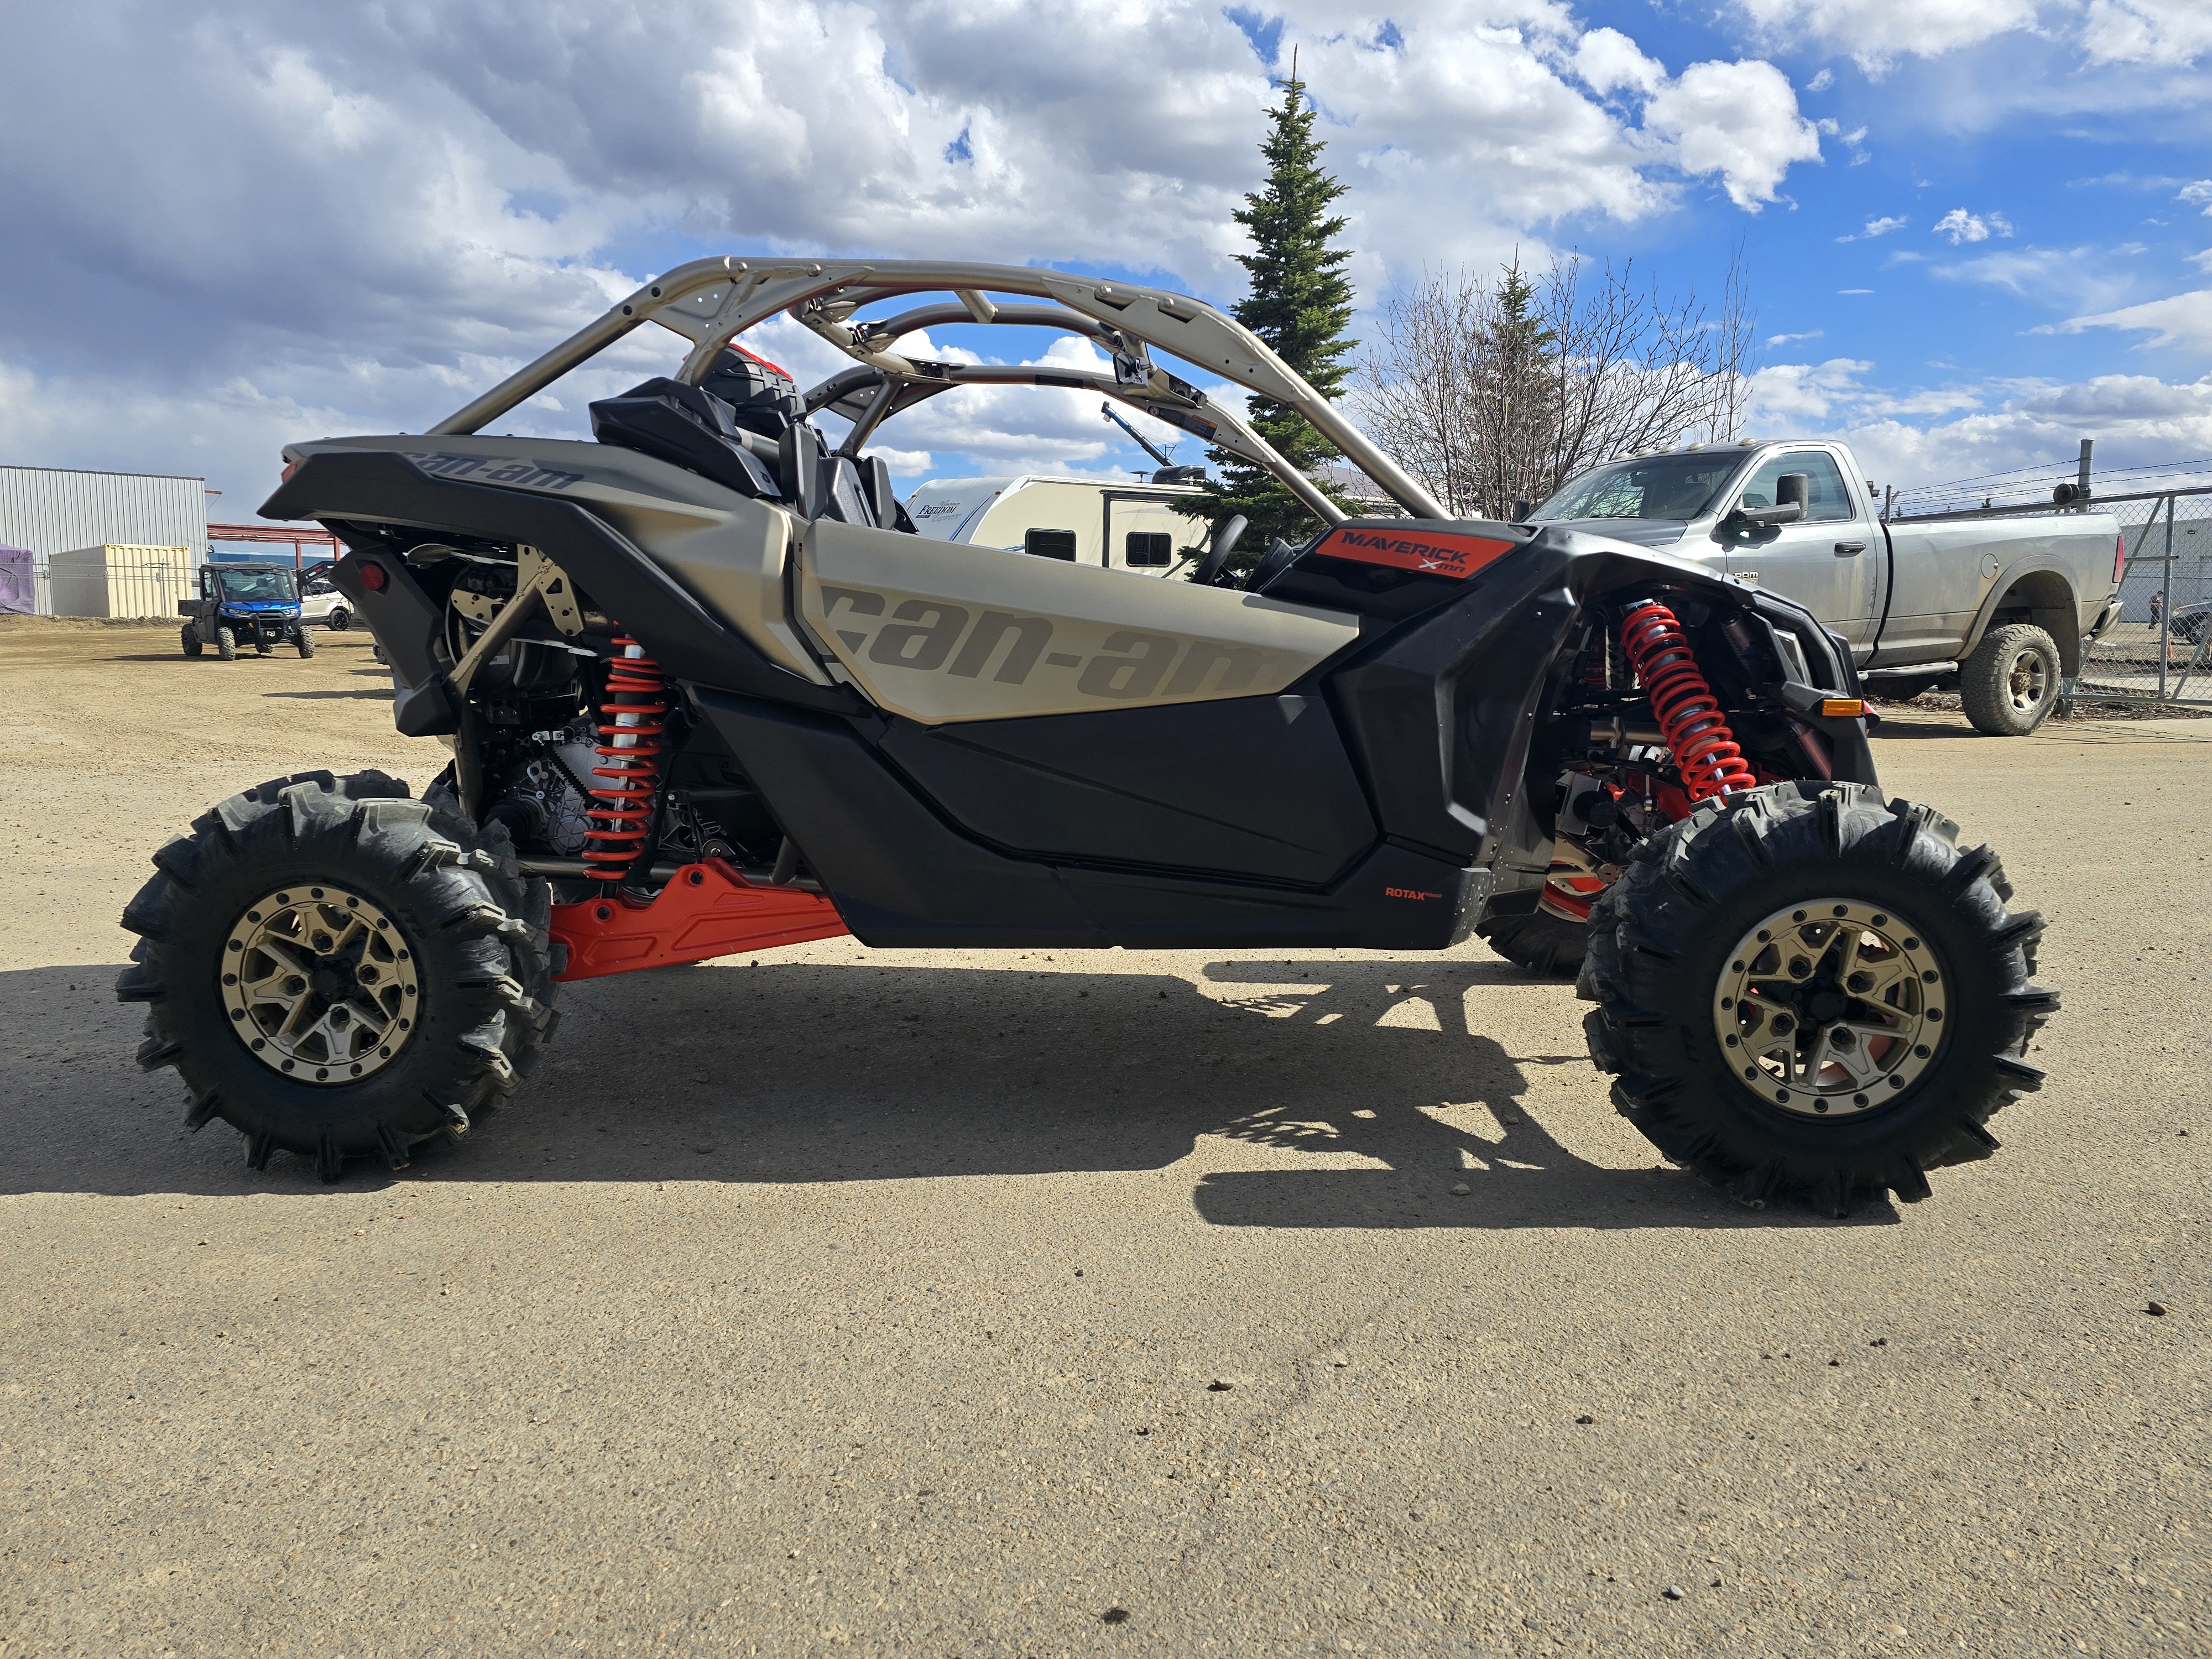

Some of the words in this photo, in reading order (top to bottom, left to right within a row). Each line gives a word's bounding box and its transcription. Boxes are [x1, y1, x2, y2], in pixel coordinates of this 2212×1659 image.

[918, 505, 958, 514] FREEDOM
[1341, 531, 1472, 564] MAVERICK
[1385, 887, 1426, 901] ROTAX
